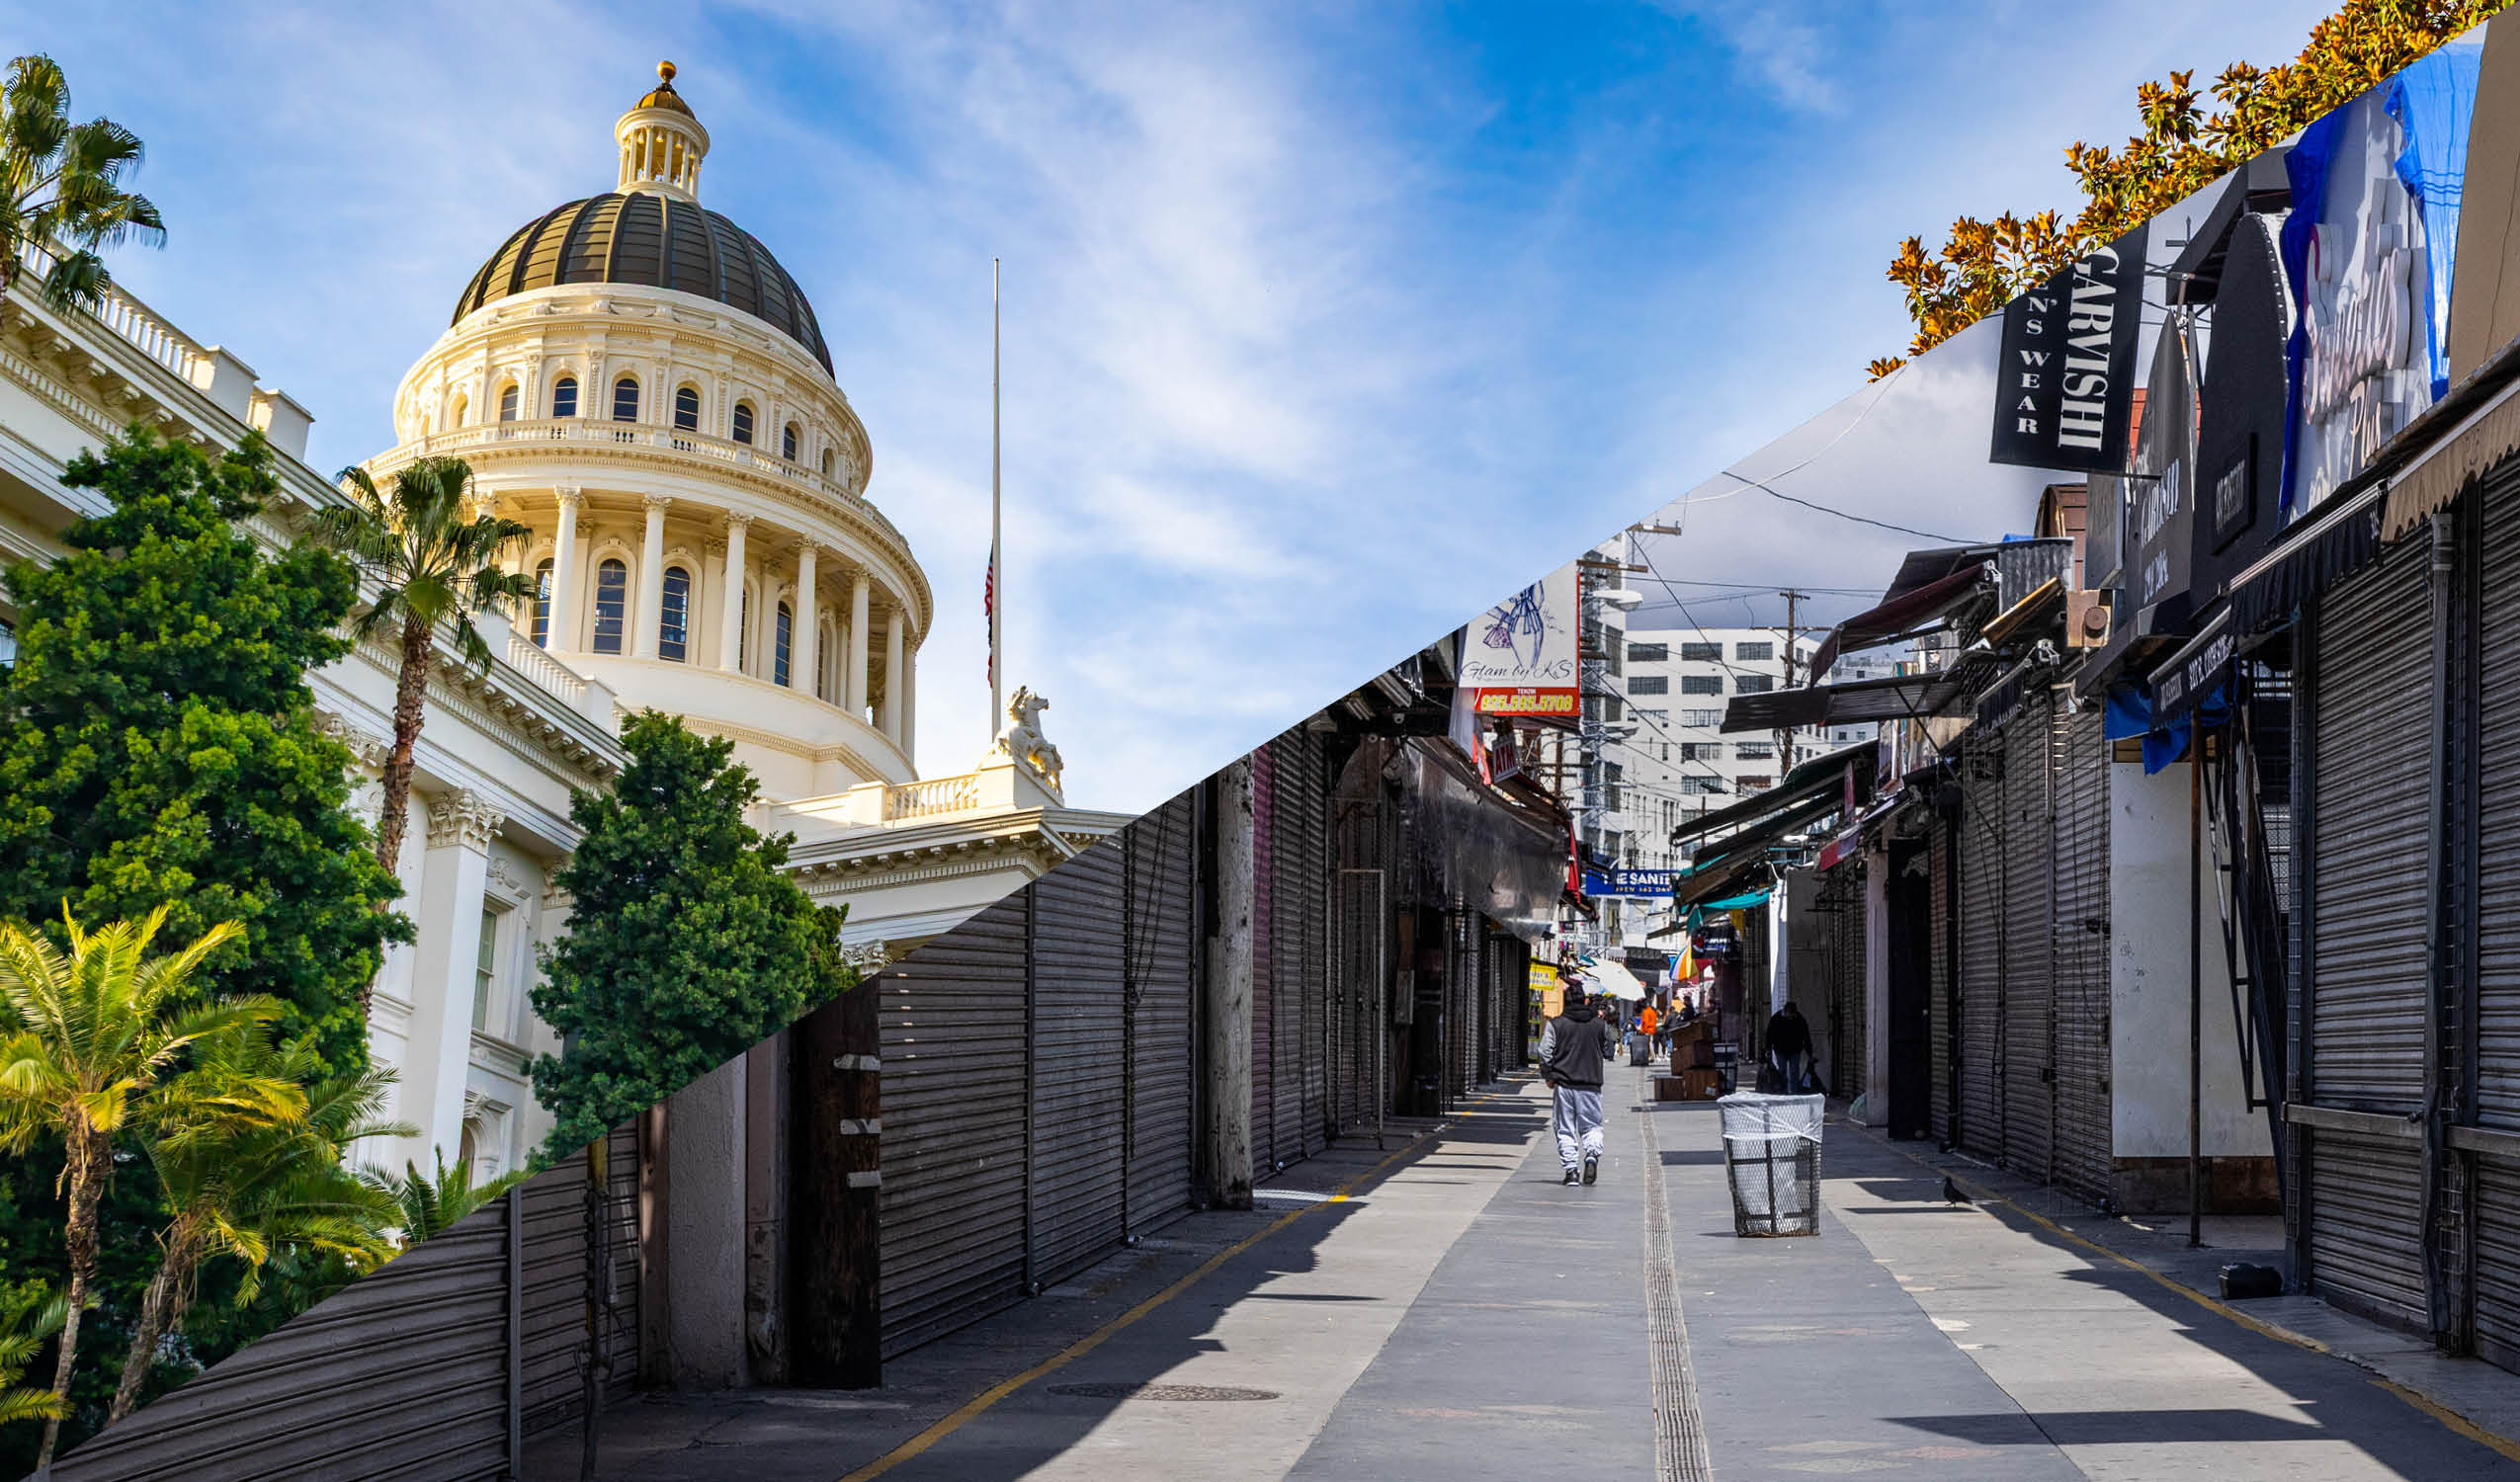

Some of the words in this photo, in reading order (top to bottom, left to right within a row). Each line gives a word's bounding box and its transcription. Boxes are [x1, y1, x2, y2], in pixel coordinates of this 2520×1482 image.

[2058, 246, 2120, 452] GARVISHI
[2016, 350, 2052, 435] WEAR
[1461, 661, 1508, 680] Glam
[1512, 665, 1530, 681] by
[1495, 743, 1517, 776] ATM
